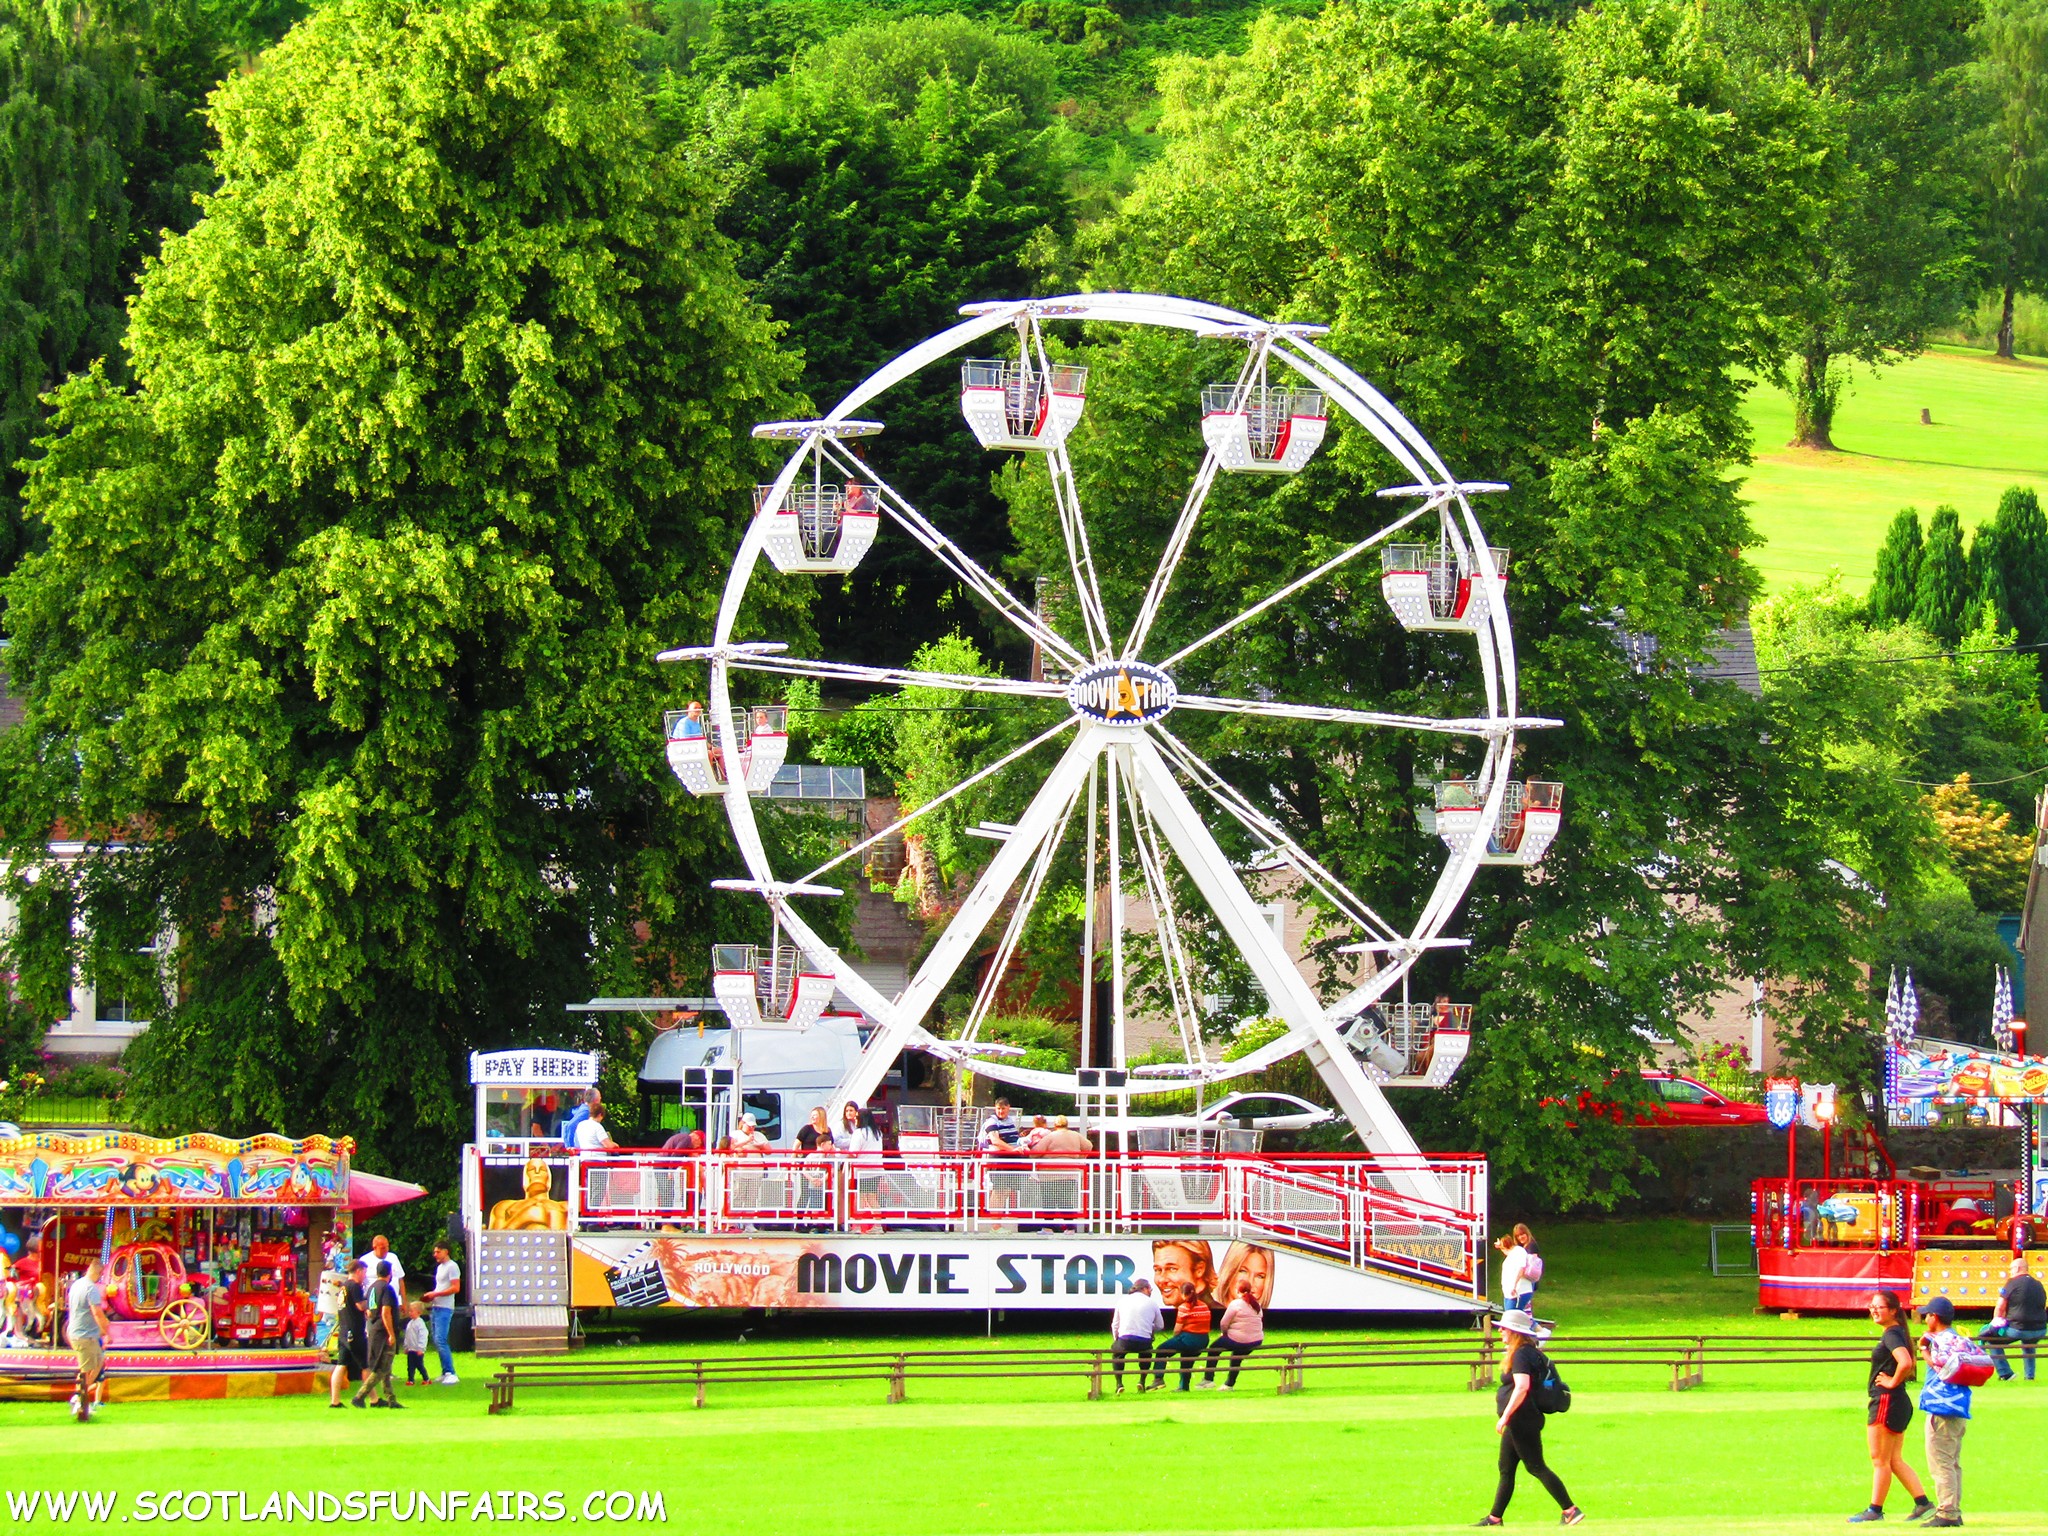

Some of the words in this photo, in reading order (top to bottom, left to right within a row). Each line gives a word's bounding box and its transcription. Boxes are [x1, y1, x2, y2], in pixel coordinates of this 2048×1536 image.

[1077, 676, 1124, 711] MOVIE
[1130, 676, 1169, 711] STAR
[485, 1058, 525, 1076] PAY
[532, 1057, 590, 1077] HERE
[1774, 1101, 1791, 1122] 66
[694, 1262, 770, 1276] HOLLYWOOD
[797, 1252, 970, 1294] MOVIE
[995, 1253, 1136, 1295] STAR
